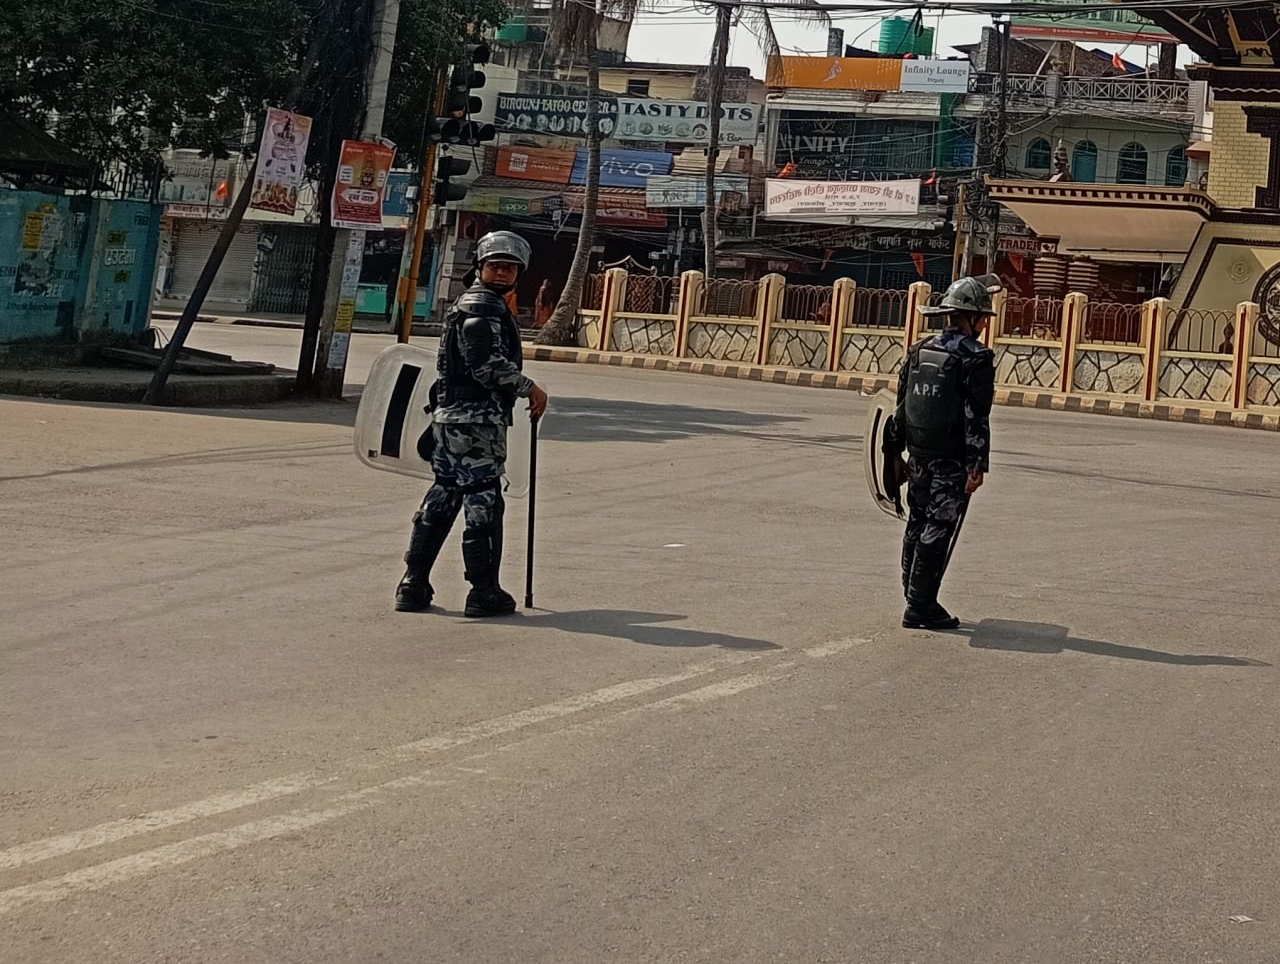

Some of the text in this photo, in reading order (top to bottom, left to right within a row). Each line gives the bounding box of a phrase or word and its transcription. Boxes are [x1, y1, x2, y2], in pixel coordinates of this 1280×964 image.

[904, 65, 967, 77] Infinity Lounge
[500, 97, 540, 111] BIRGUNJ
[572, 100, 609, 114] CENER
[622, 102, 690, 117] TASTY
[600, 157, 654, 176] vivo
[1000, 238, 1041, 251] TRADER
